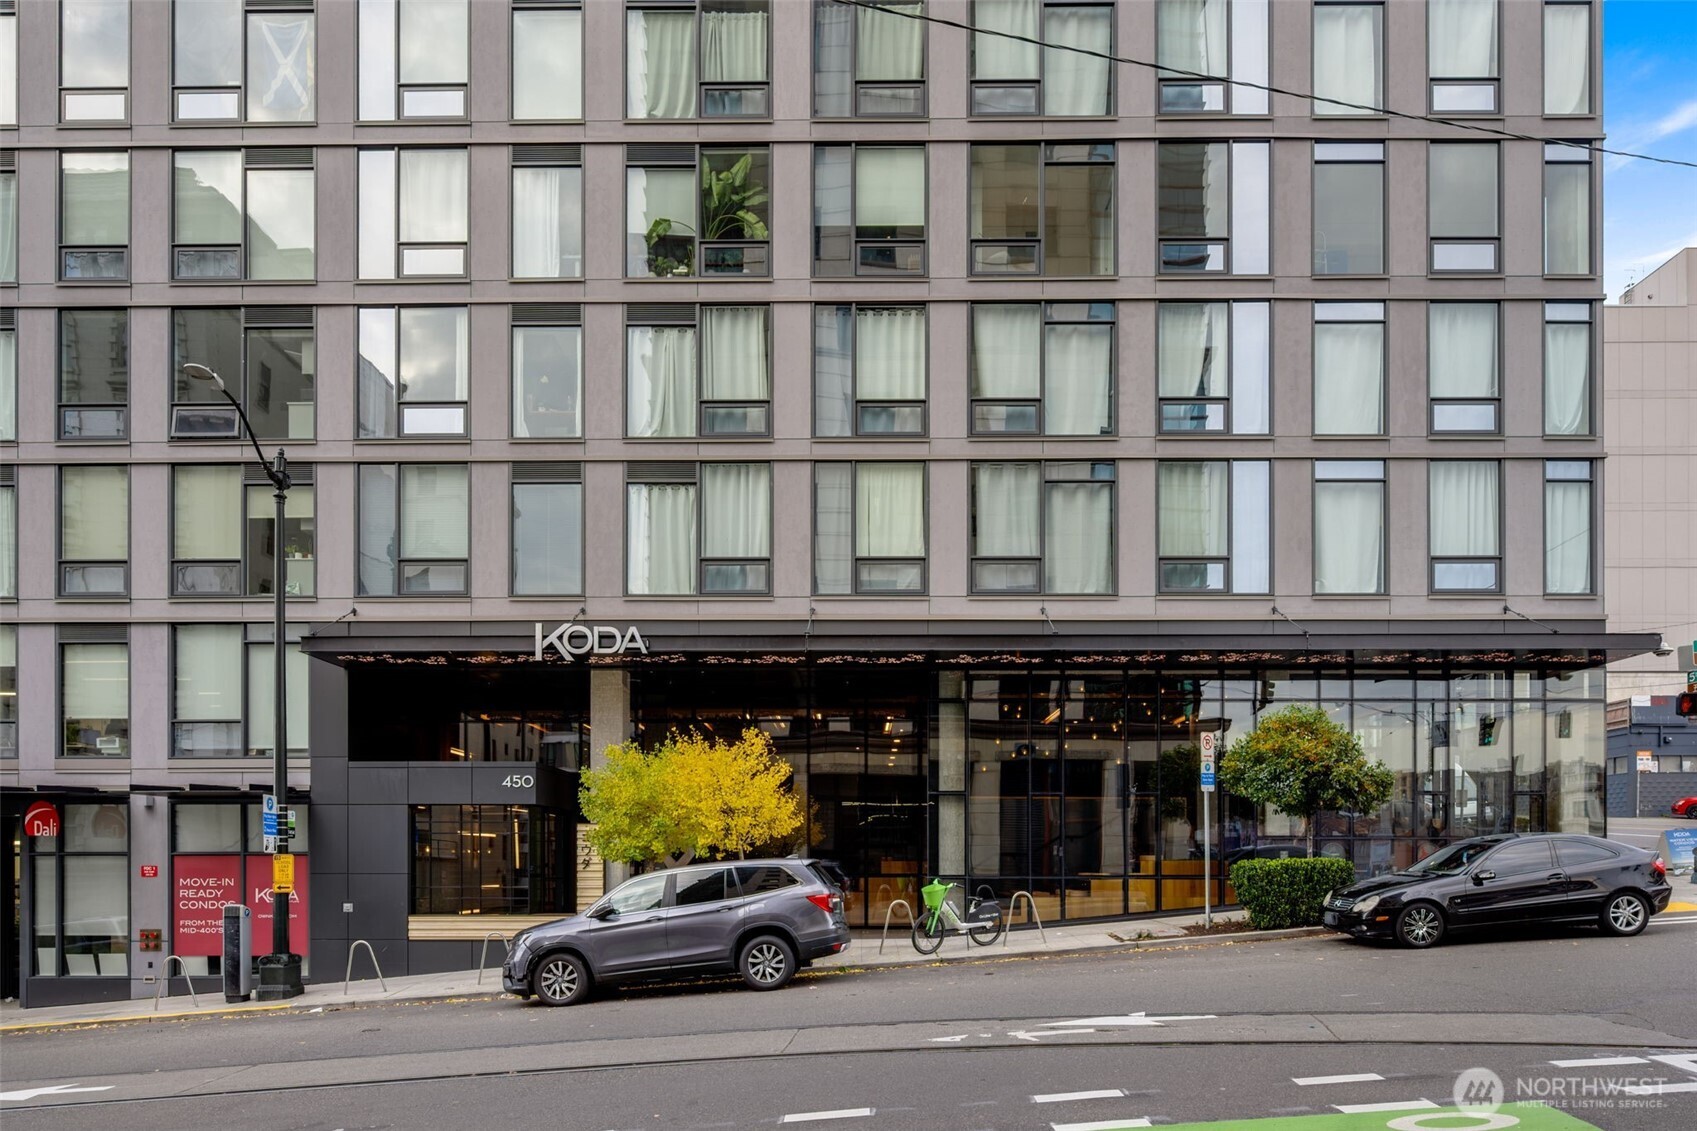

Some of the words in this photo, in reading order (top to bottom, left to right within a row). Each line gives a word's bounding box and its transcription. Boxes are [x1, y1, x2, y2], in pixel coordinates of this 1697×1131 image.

[535, 622, 648, 661] KODA
[502, 775, 534, 788] 450
[34, 818, 57, 836] Dali
[179, 878, 234, 887] MOVE-IN
[179, 889, 224, 898] READY
[255, 887, 299, 903] KOA
